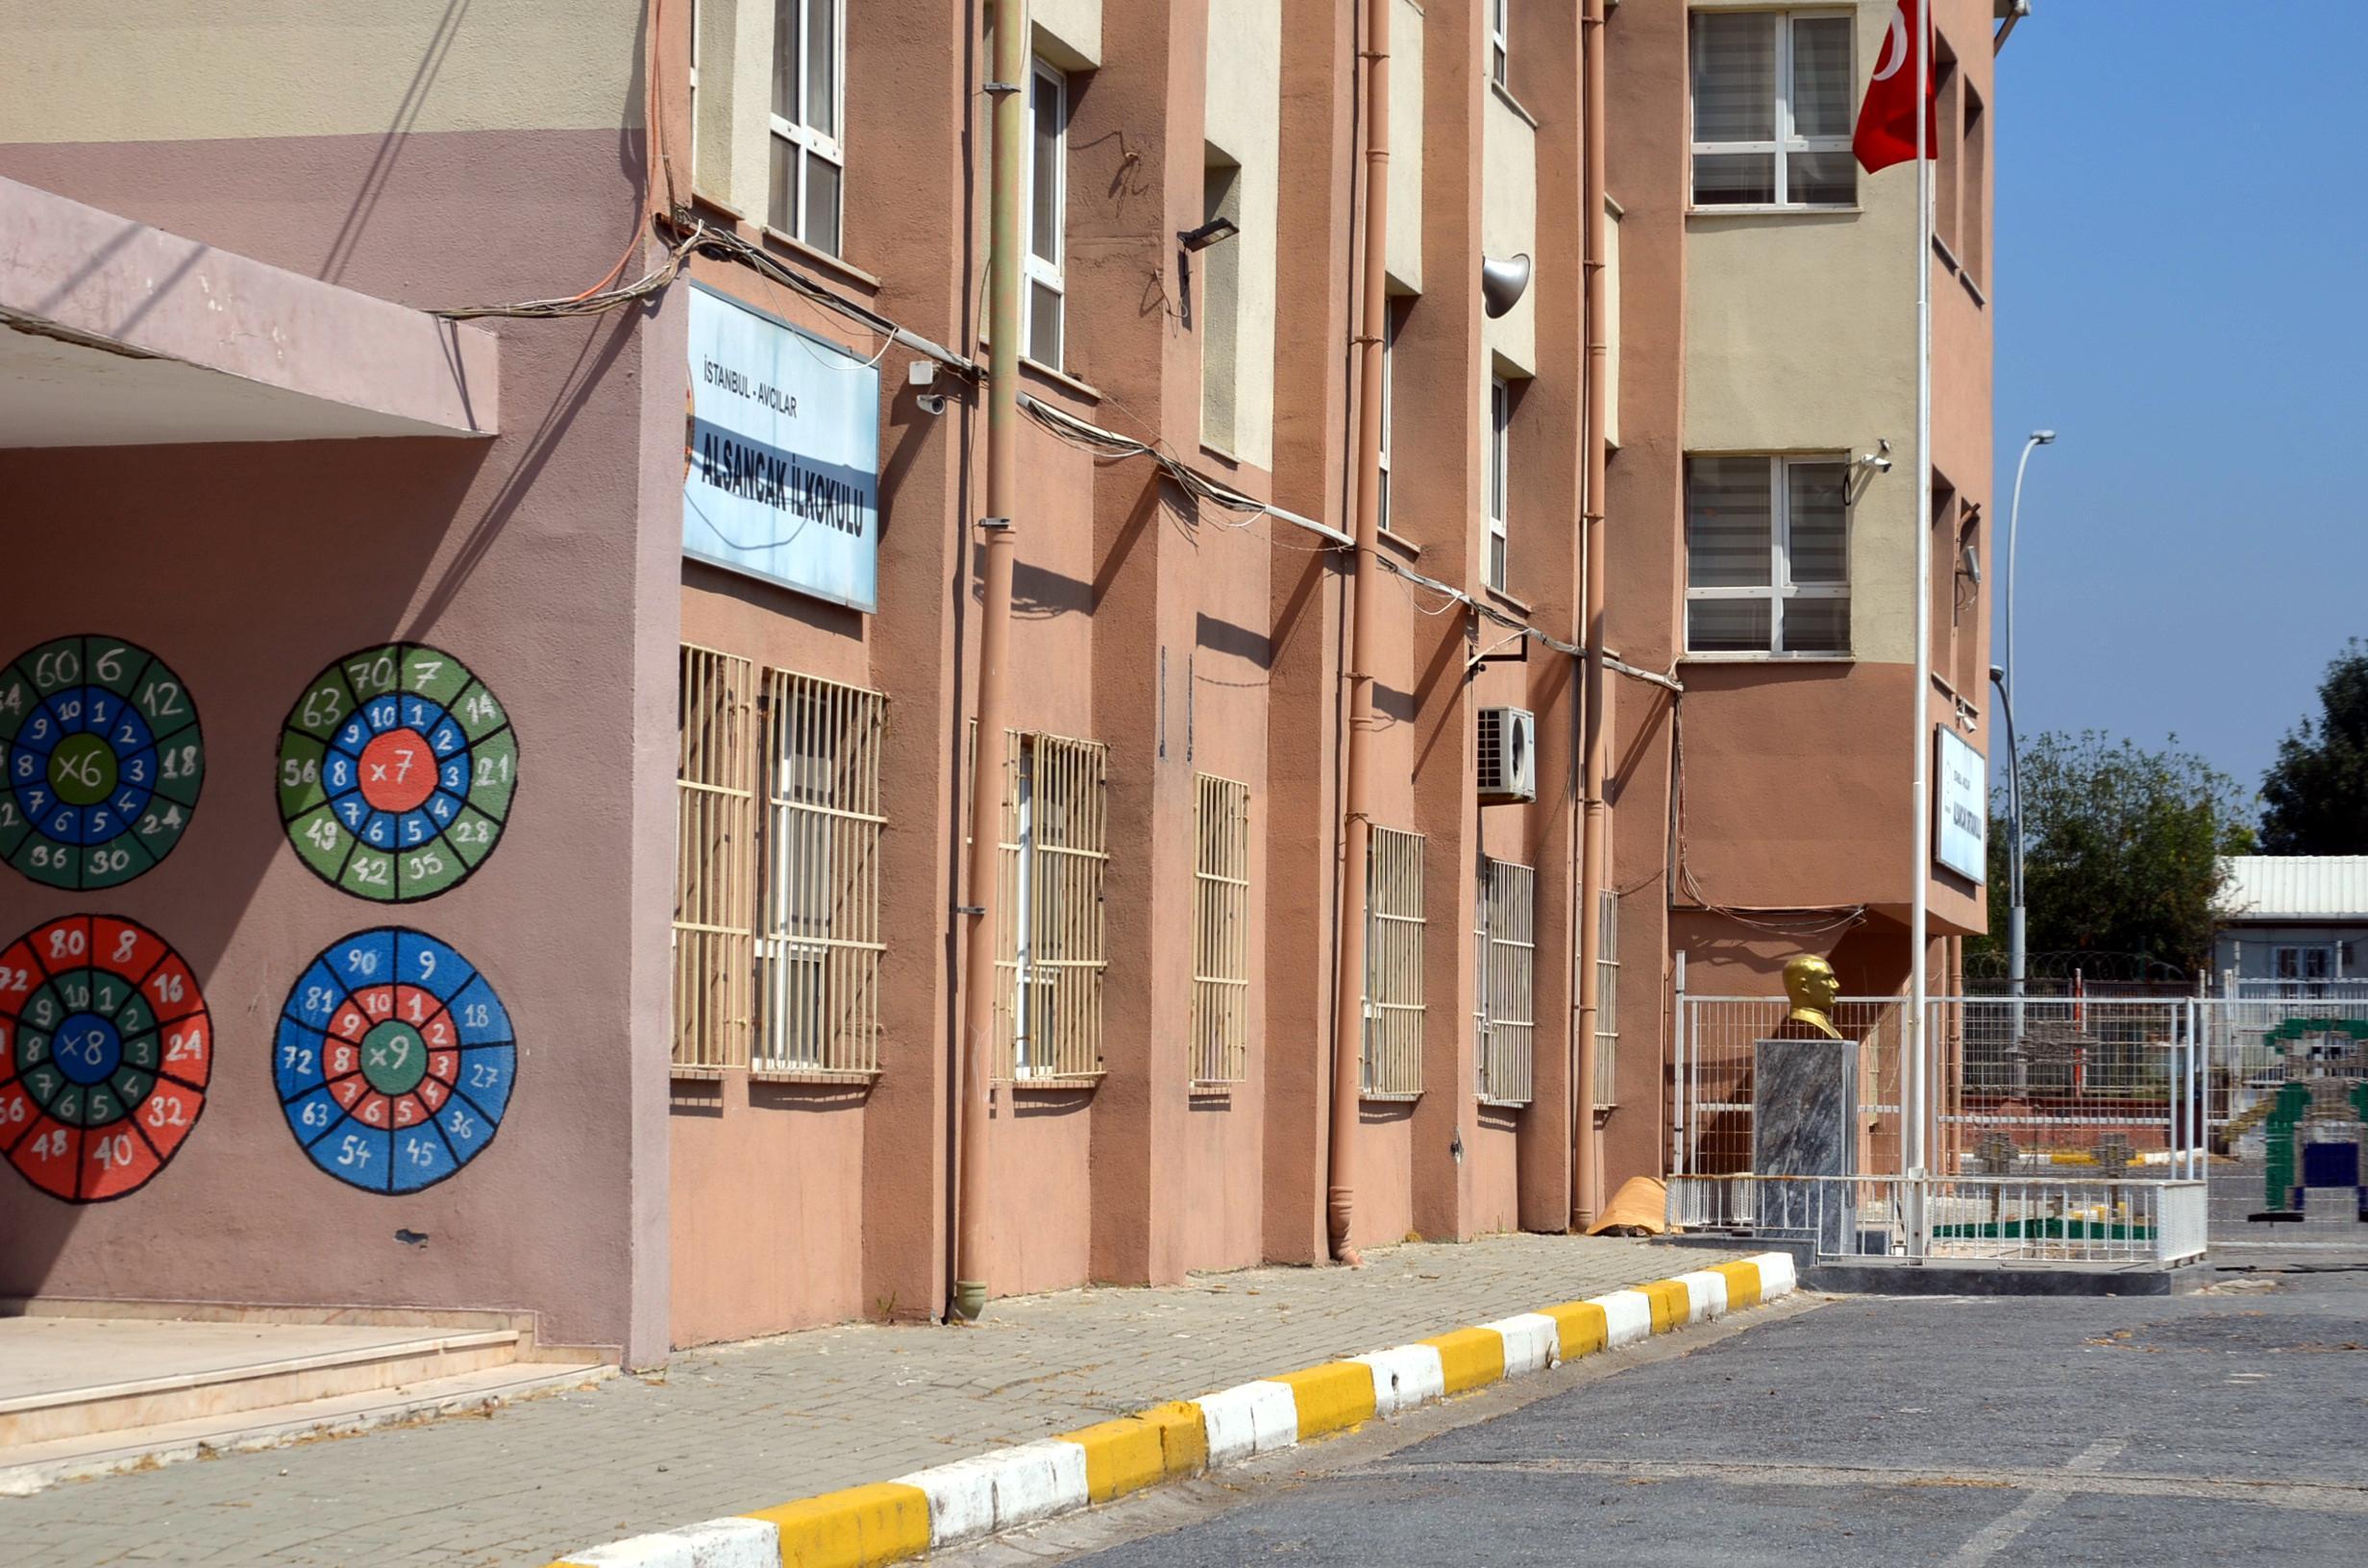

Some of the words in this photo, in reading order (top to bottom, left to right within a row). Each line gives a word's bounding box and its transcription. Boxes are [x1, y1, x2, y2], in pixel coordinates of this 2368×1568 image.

[703, 354, 751, 399] İSTANBUL
[757, 382, 798, 419] AVCILAR
[702, 432, 787, 512] ALSANCAK
[790, 453, 864, 538] İLKOKULU
[36, 649, 79, 687] 60
[96, 648, 126, 681] 6
[349, 657, 392, 693] 70
[413, 661, 443, 690] 7
[58, 700, 81, 721] 10
[92, 701, 107, 723] 1
[143, 682, 184, 717] 12
[303, 687, 341, 727] 63
[466, 693, 496, 724] 14
[371, 706, 395, 727] 10
[410, 704, 425, 725] 1
[31, 719, 47, 740] 9
[118, 725, 137, 744] 2
[344, 724, 358, 744] 9
[437, 729, 453, 751] 2
[17, 754, 34, 776] 8
[130, 759, 144, 782] 3
[162, 746, 197, 779] 18
[284, 759, 316, 787] 56
[333, 760, 346, 786] 8
[475, 753, 508, 787] 21
[446, 768, 459, 787] 3
[28, 791, 44, 814] 7
[118, 791, 136, 812] 4
[342, 803, 359, 825] 7
[434, 798, 449, 818] 4
[54, 811, 74, 831] 6
[92, 812, 109, 832] 5
[141, 805, 182, 834] 24
[370, 821, 383, 842] 6
[407, 821, 422, 841] 5
[306, 819, 337, 850] 49
[456, 821, 489, 844] 28
[30, 845, 67, 869] 36
[88, 849, 130, 874] 30
[409, 852, 443, 879] 35
[352, 857, 388, 885] 42
[49, 929, 85, 959] 80
[112, 930, 137, 963] 8
[348, 948, 378, 975] 90
[419, 950, 436, 980] 9
[64, 984, 89, 1008] 10
[99, 986, 114, 1012] 1
[153, 973, 184, 1003] 16
[305, 987, 333, 1013] 81
[36, 999, 53, 1027] 9
[366, 992, 390, 1014] 10
[407, 992, 424, 1021] 1
[465, 1004, 489, 1027] 18
[126, 1009, 139, 1032] 2
[342, 1014, 360, 1037] 9
[165, 1030, 202, 1062] 24
[432, 1023, 448, 1045] 2
[27, 1036, 42, 1062] 8
[136, 1042, 150, 1065] 3
[283, 1046, 313, 1075] 72
[333, 1046, 351, 1071] 8
[436, 1056, 449, 1077] 3
[470, 1064, 499, 1089] 27
[36, 1074, 54, 1098] 7
[123, 1075, 138, 1097] 4
[342, 1083, 357, 1103] 7
[425, 1082, 439, 1105] 4
[60, 1094, 76, 1117] 6
[92, 1095, 109, 1119] 5
[148, 1096, 186, 1127] 32
[302, 1102, 328, 1127] 63
[364, 1100, 382, 1122] 6
[397, 1102, 414, 1122] 5
[449, 1111, 472, 1139] 36
[31, 1129, 68, 1162] 48
[94, 1134, 133, 1170] 40
[337, 1136, 372, 1168] 54
[407, 1138, 436, 1166] 45
